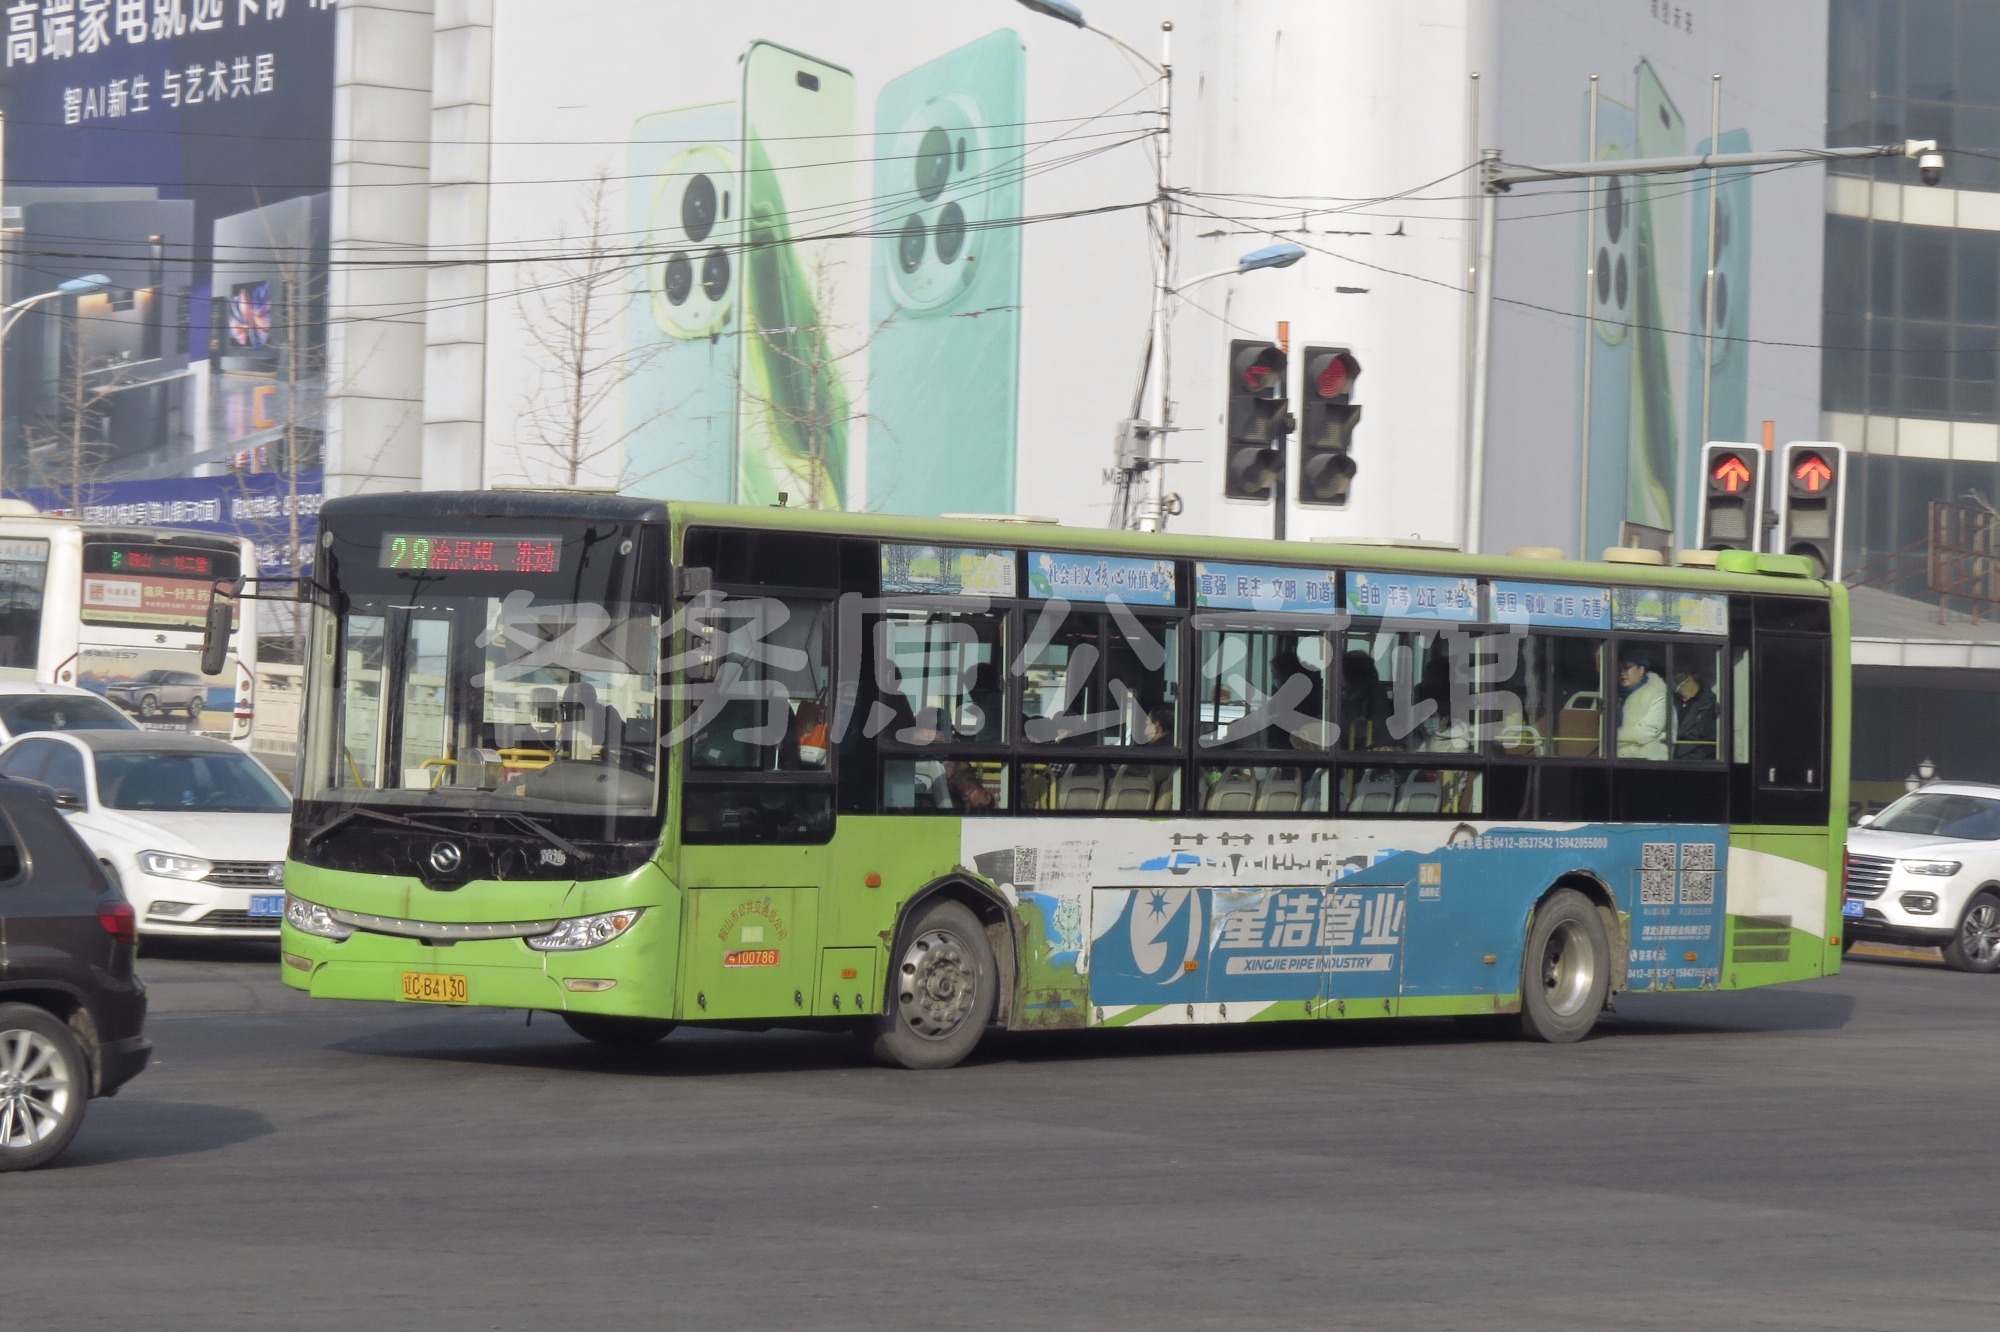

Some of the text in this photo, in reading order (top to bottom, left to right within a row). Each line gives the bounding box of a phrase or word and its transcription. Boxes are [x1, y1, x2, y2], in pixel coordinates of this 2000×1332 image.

[63, 54, 276, 125] 智AI新生 与艺术共居
[1048, 562, 1161, 592] 社会主义核心价值观
[1201, 574, 1331, 602] 富强 民主 文明 和谐
[1361, 584, 1465, 609] 自由 平等 公正 法治
[1495, 592, 1602, 619] 爱国 敬业 诚信 友善
[1219, 893, 1403, 949] 星洁管业
[1244, 956, 1373, 971] XINGJIE PIPE INDUSTRY
